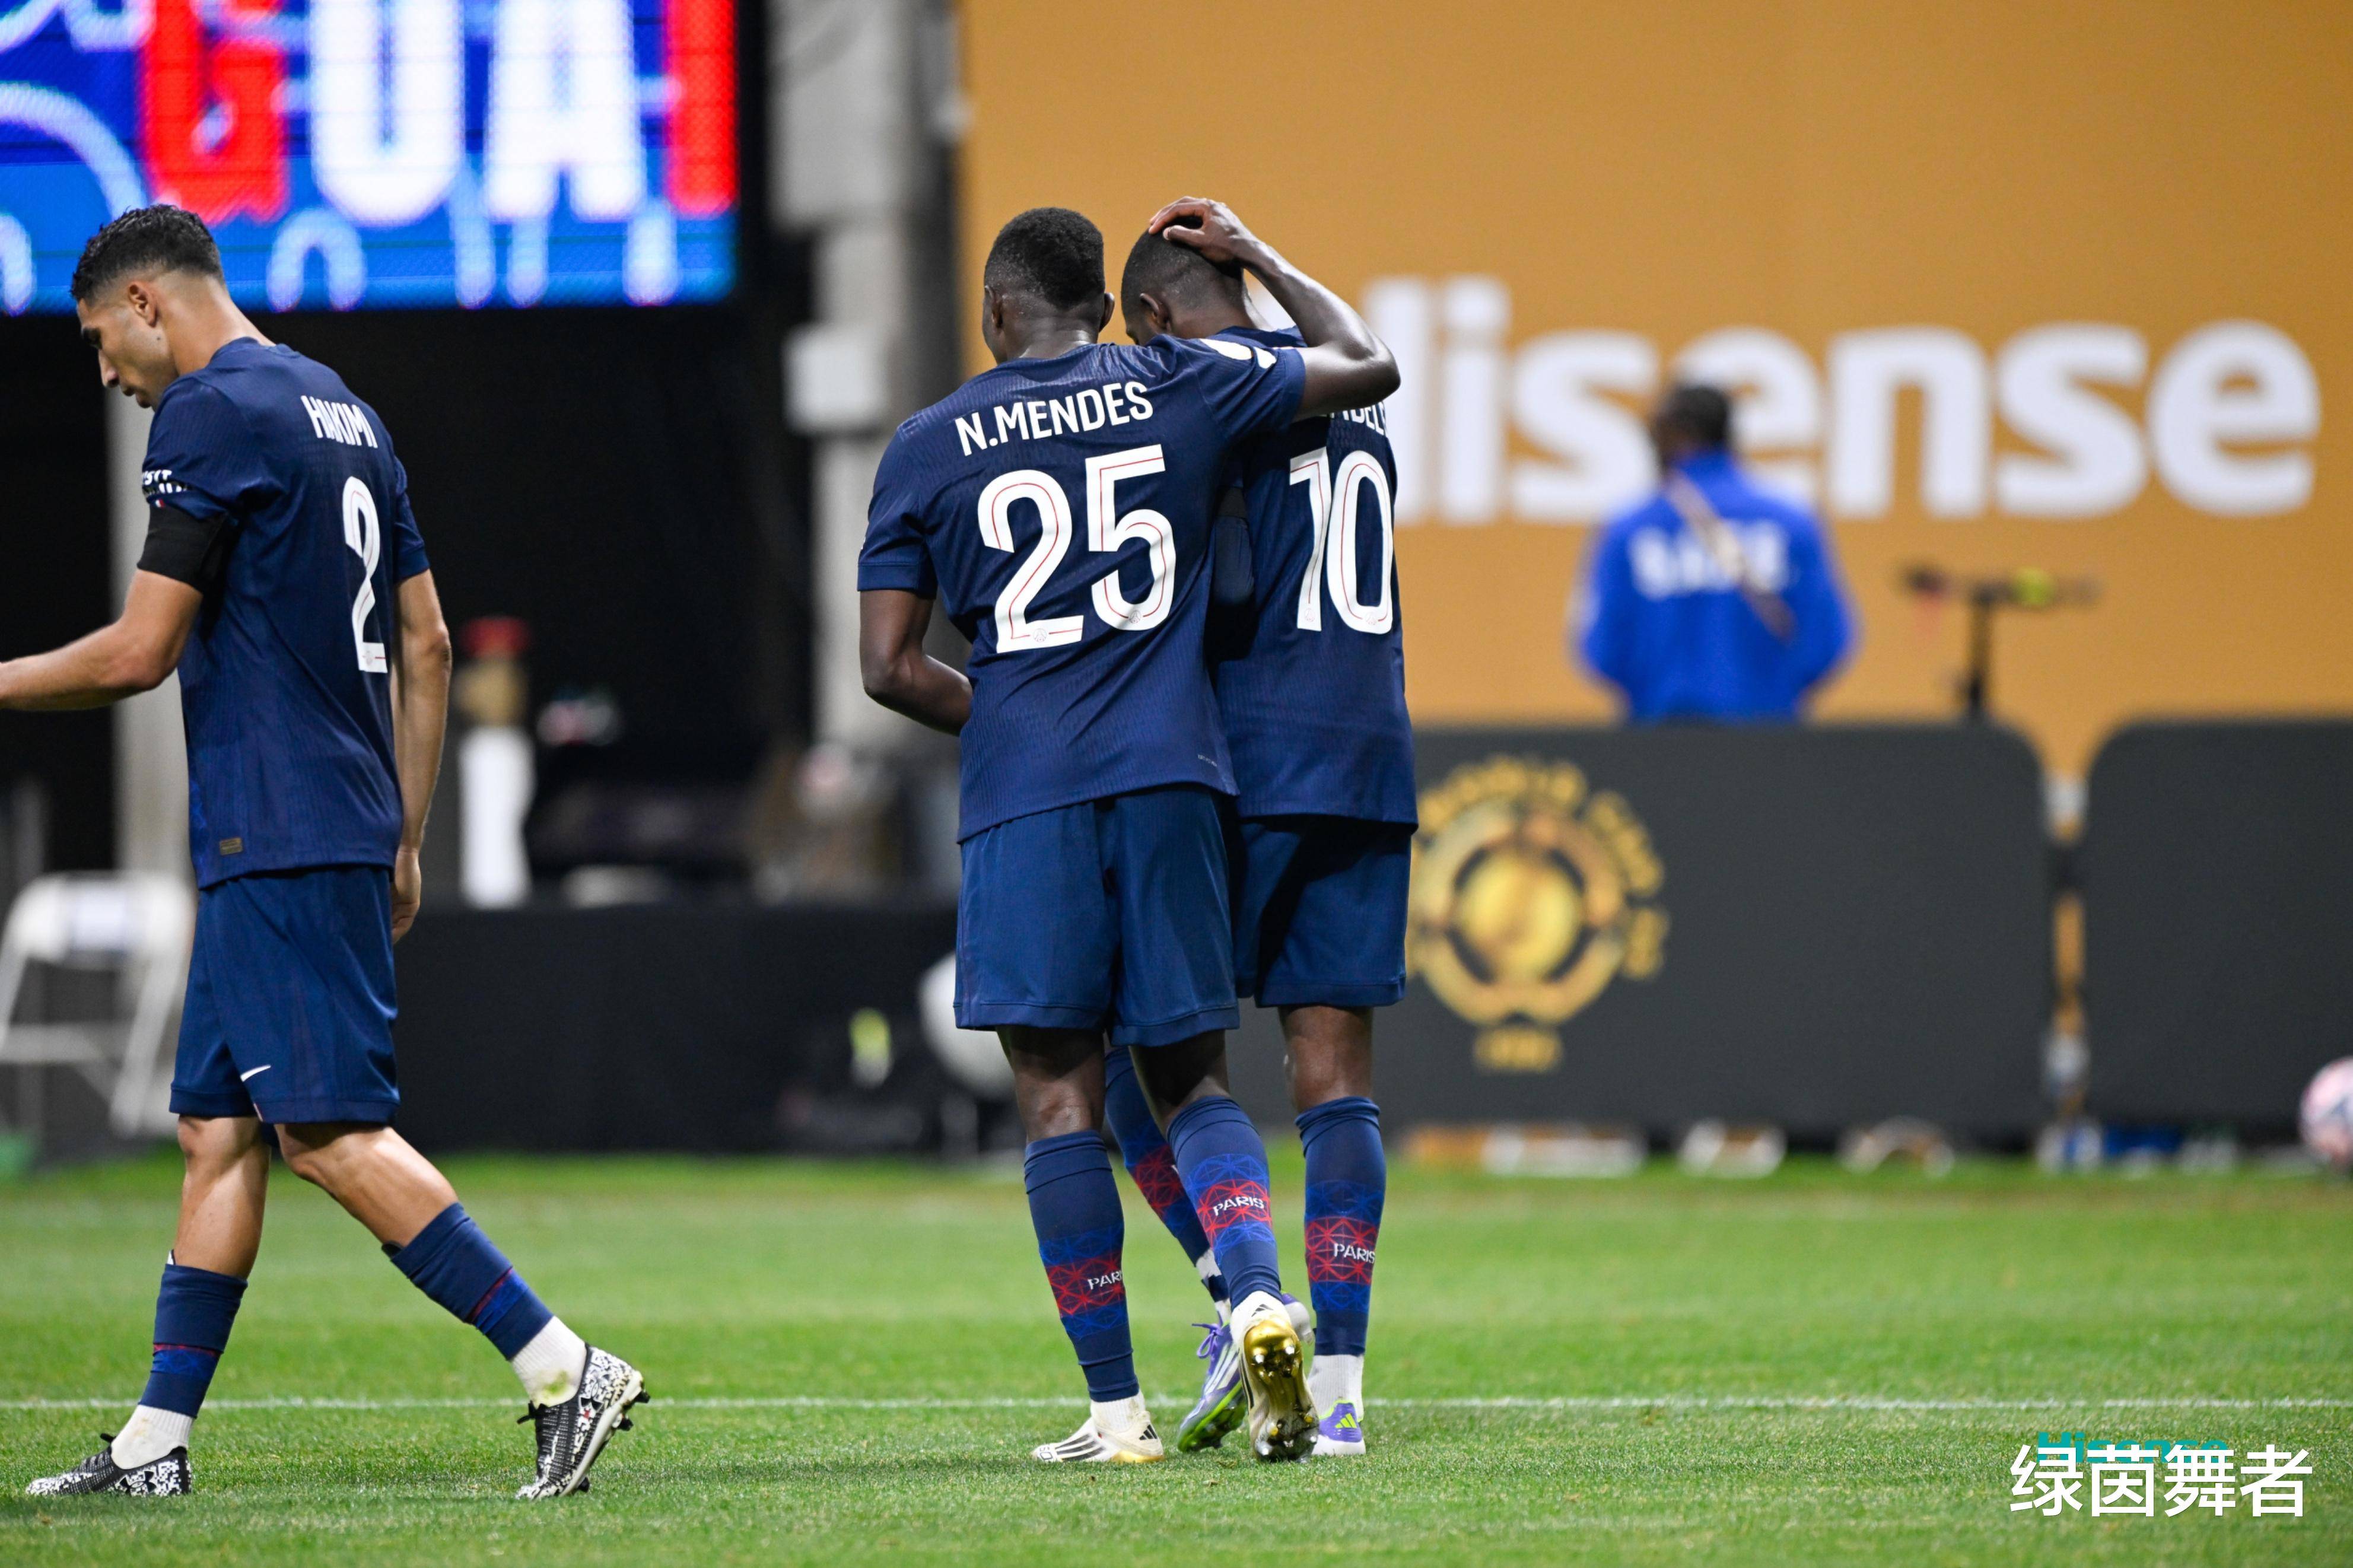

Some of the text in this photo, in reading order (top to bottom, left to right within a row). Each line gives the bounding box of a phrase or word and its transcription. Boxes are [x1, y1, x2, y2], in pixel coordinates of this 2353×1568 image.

[300, 395, 378, 449] HAKIMI
[955, 381, 1153, 456] N.MENDES
[342, 476, 388, 673] 2
[977, 444, 1176, 654] 25
[1289, 447, 1394, 634] 10
[1213, 1196, 1264, 1216] PARIS
[1334, 1243, 1375, 1264] PARIS
